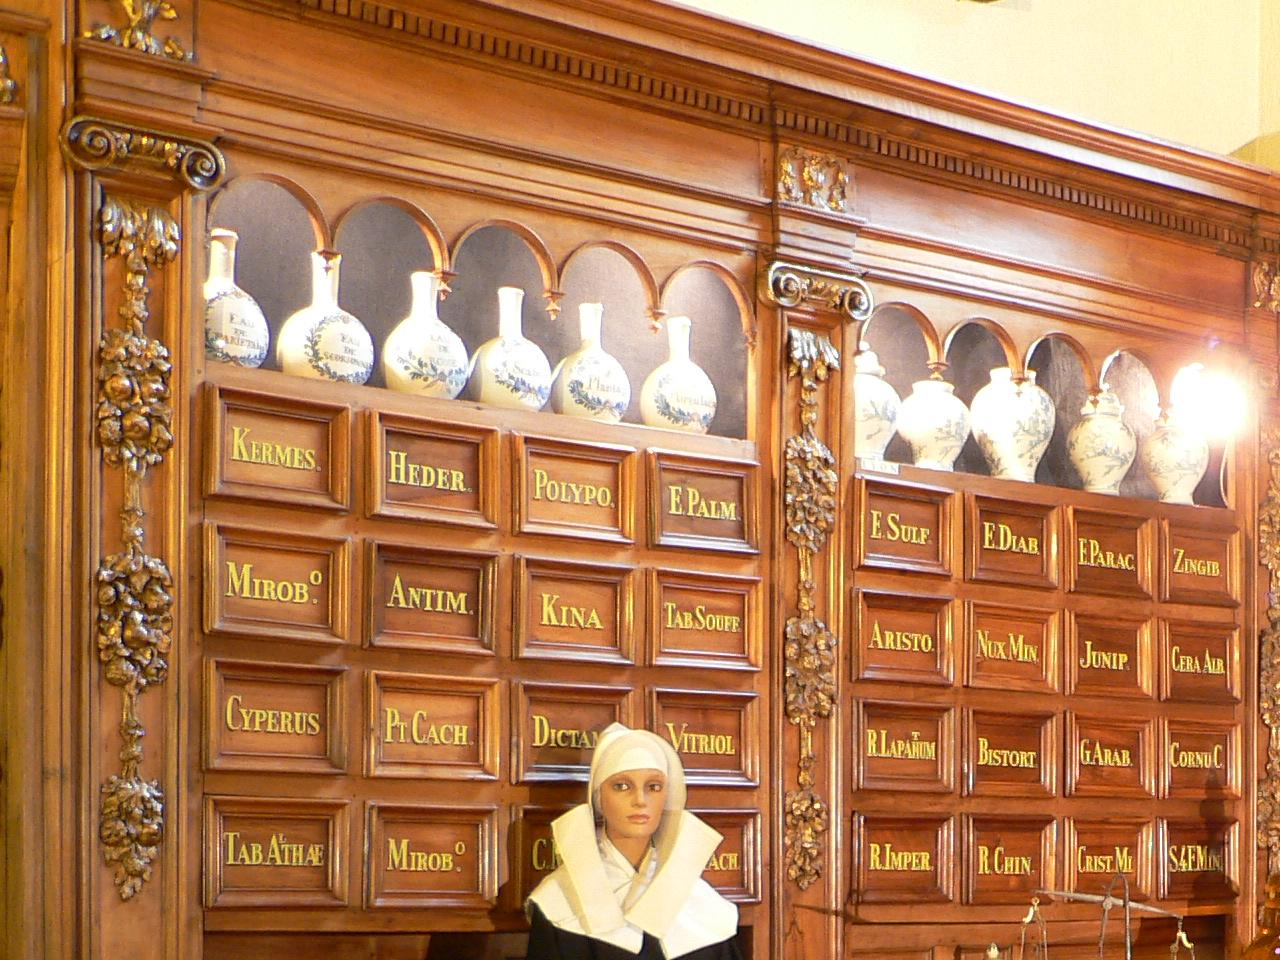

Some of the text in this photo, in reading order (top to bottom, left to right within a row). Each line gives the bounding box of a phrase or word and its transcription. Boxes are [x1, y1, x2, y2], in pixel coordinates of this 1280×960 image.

[540, 593, 604, 630] KINA
[225, 695, 320, 736] CYPERUS
[665, 722, 736, 756] VITRIOL
